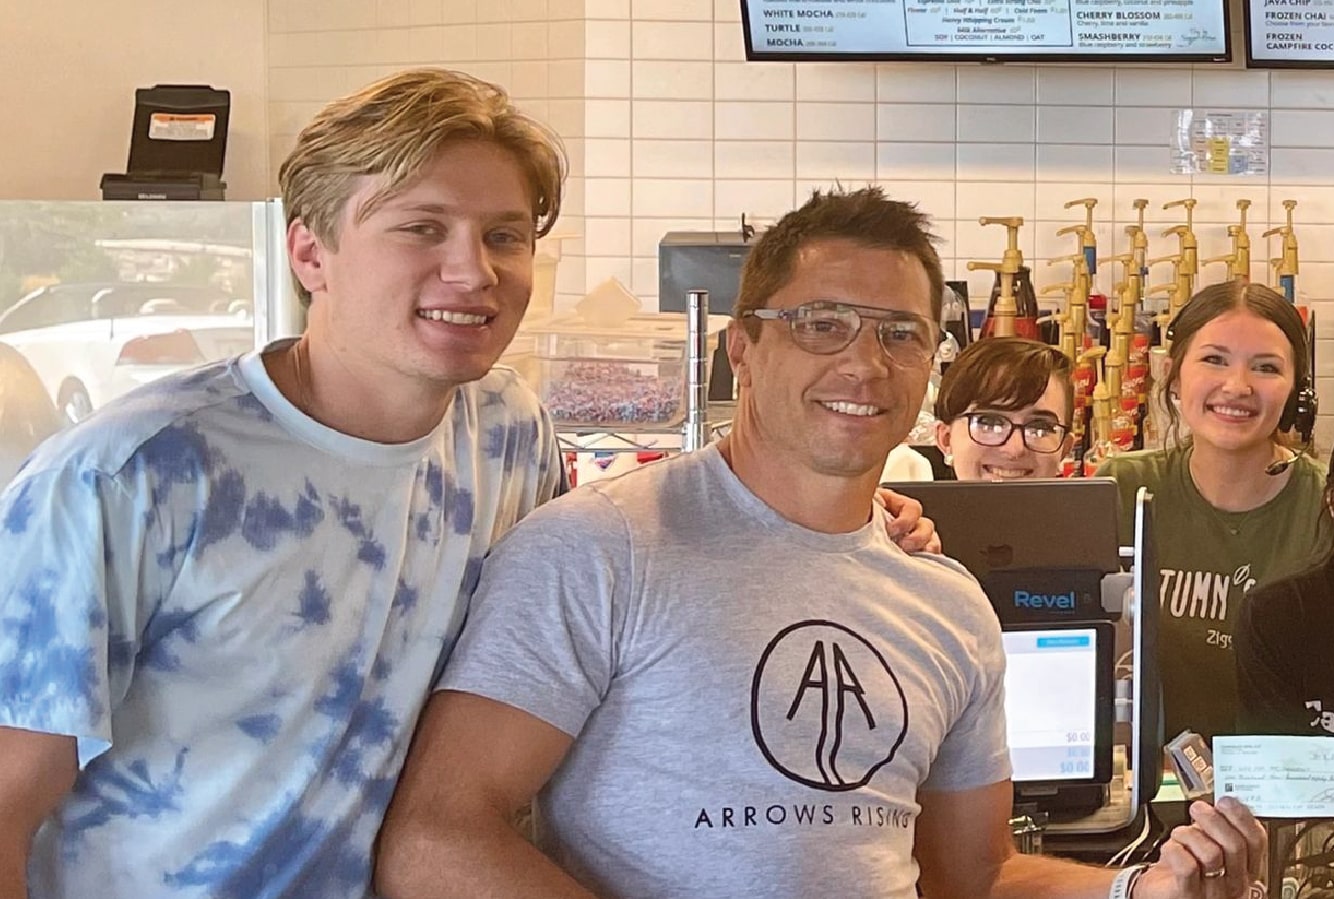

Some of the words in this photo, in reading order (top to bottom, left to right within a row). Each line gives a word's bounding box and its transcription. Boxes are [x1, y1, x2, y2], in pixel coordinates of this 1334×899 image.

[763, 10, 794, 18] WHITE
[797, 10, 834, 18] MOCHA
[1076, 12, 1113, 20] CHERRY
[1116, 12, 1160, 20] BLOSSOM
[1265, 12, 1302, 20] FROZEN
[1304, 12, 1326, 20] CHAI
[765, 24, 800, 32] TURTLE
[766, 38, 804, 47] MOCHA
[1014, 590, 1075, 608] Revel
[694, 804, 834, 828] ARROWS
[852, 806, 911, 828] RISING
